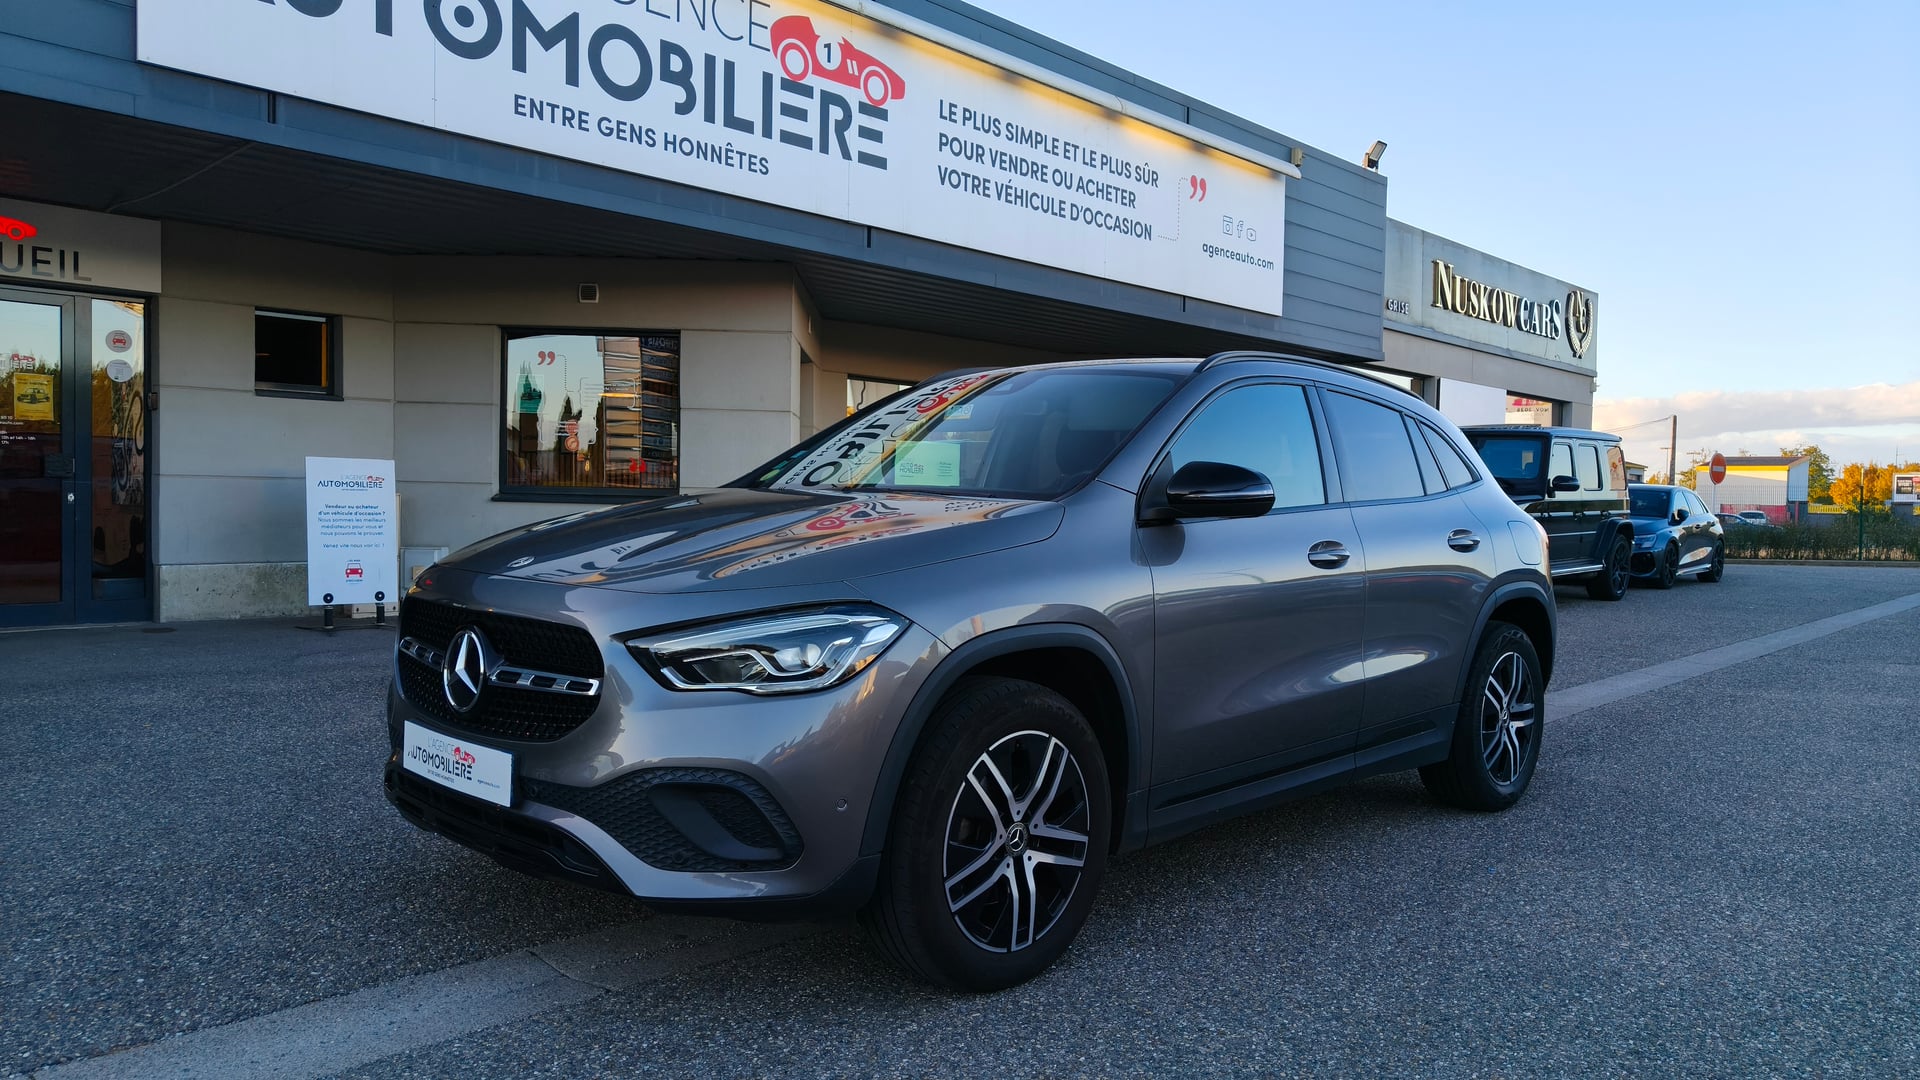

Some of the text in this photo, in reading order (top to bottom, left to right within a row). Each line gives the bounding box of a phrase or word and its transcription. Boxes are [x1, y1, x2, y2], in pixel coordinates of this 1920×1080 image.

[513, 94, 770, 176] ENTRE GENS HONNÊTES
[938, 132, 1136, 209] POUR VENDRE OU ACHETER
[939, 99, 1159, 188] LE PLUS SIMPLE ET LE PLUS SÛR
[937, 165, 1152, 241] VOTRE VÉHICULE D'OCCASION
[1202, 242, 1275, 271] agenceauto.com
[1387, 298, 1409, 315] GRISE
[317, 480, 383, 488] AUTOMOBILIERE
